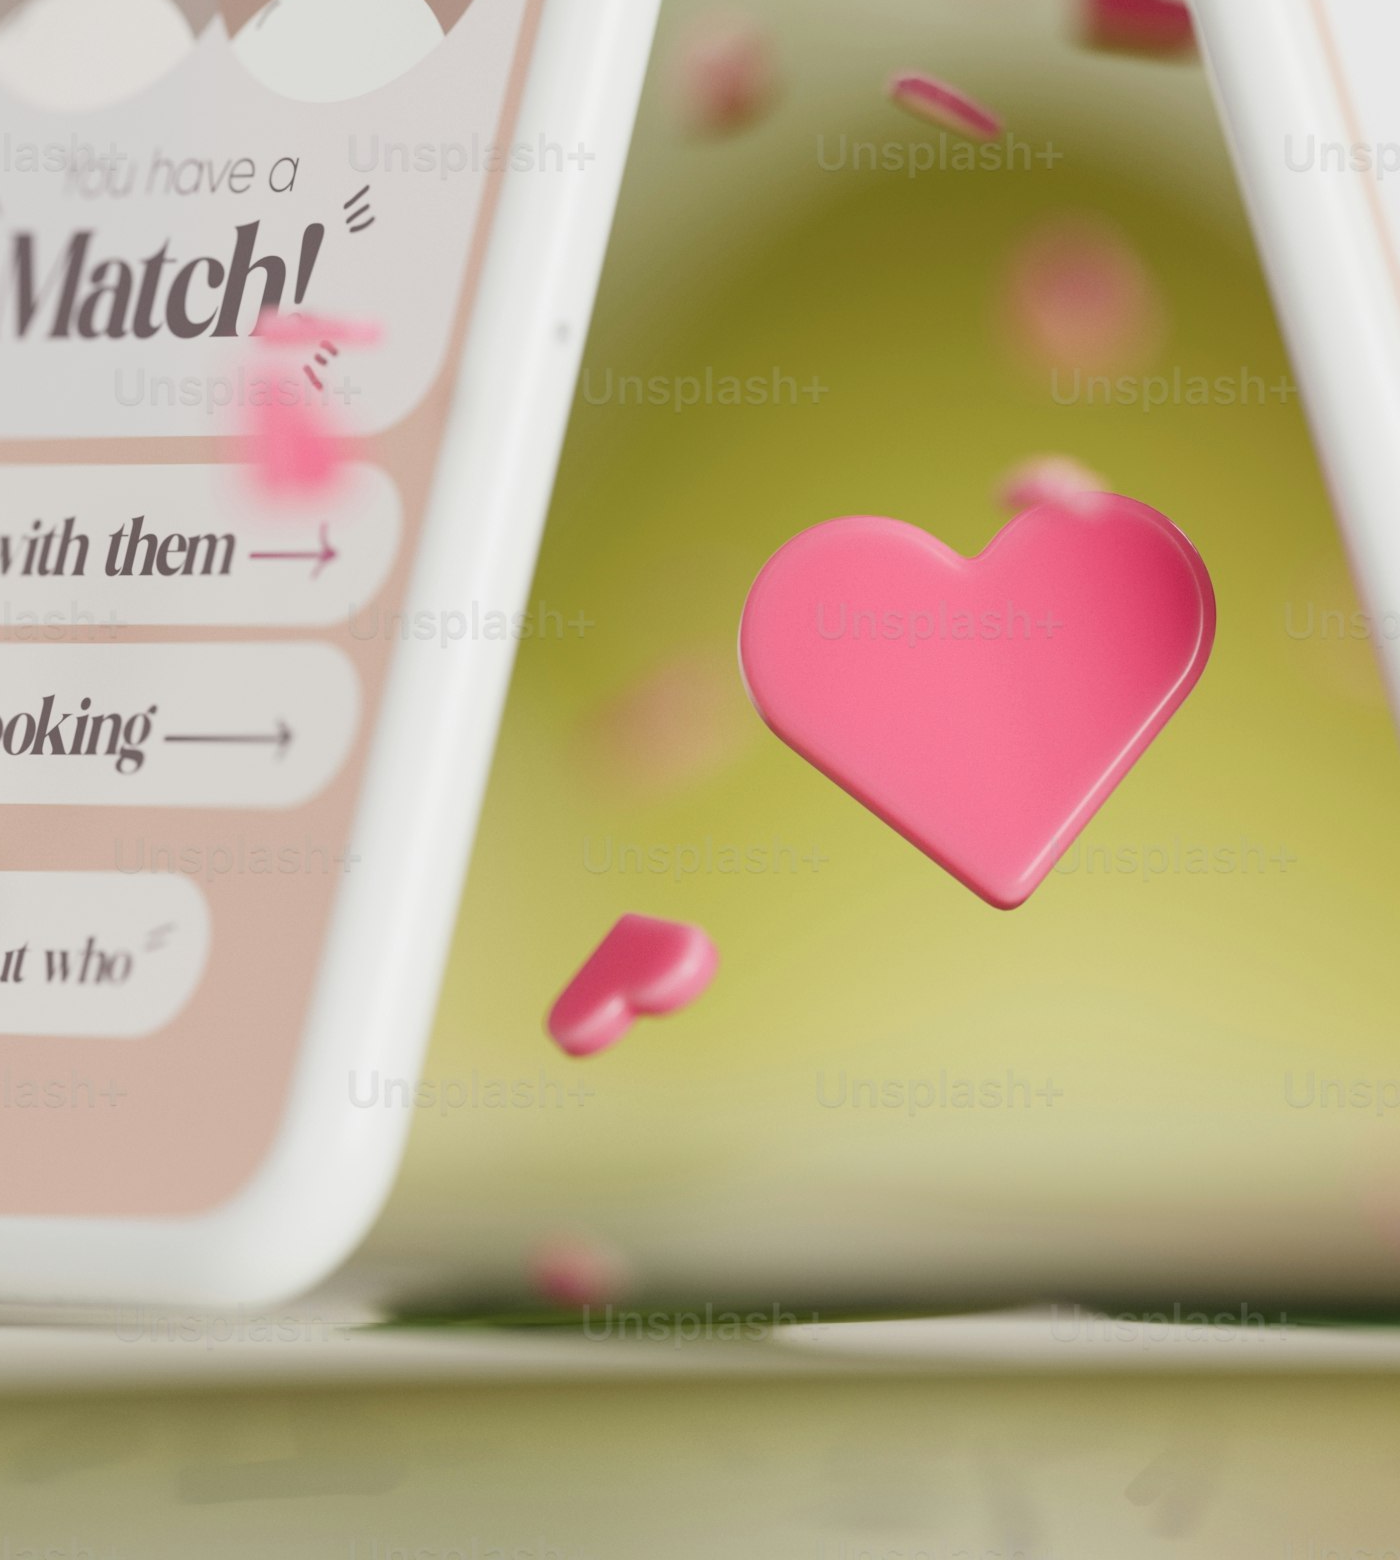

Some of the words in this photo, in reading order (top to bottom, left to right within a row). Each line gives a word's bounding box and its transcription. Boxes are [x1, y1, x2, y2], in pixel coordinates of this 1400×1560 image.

[146, 146, 256, 196] have
[269, 157, 300, 193] a
[104, 515, 237, 577] them
[44, 936, 133, 985] who
